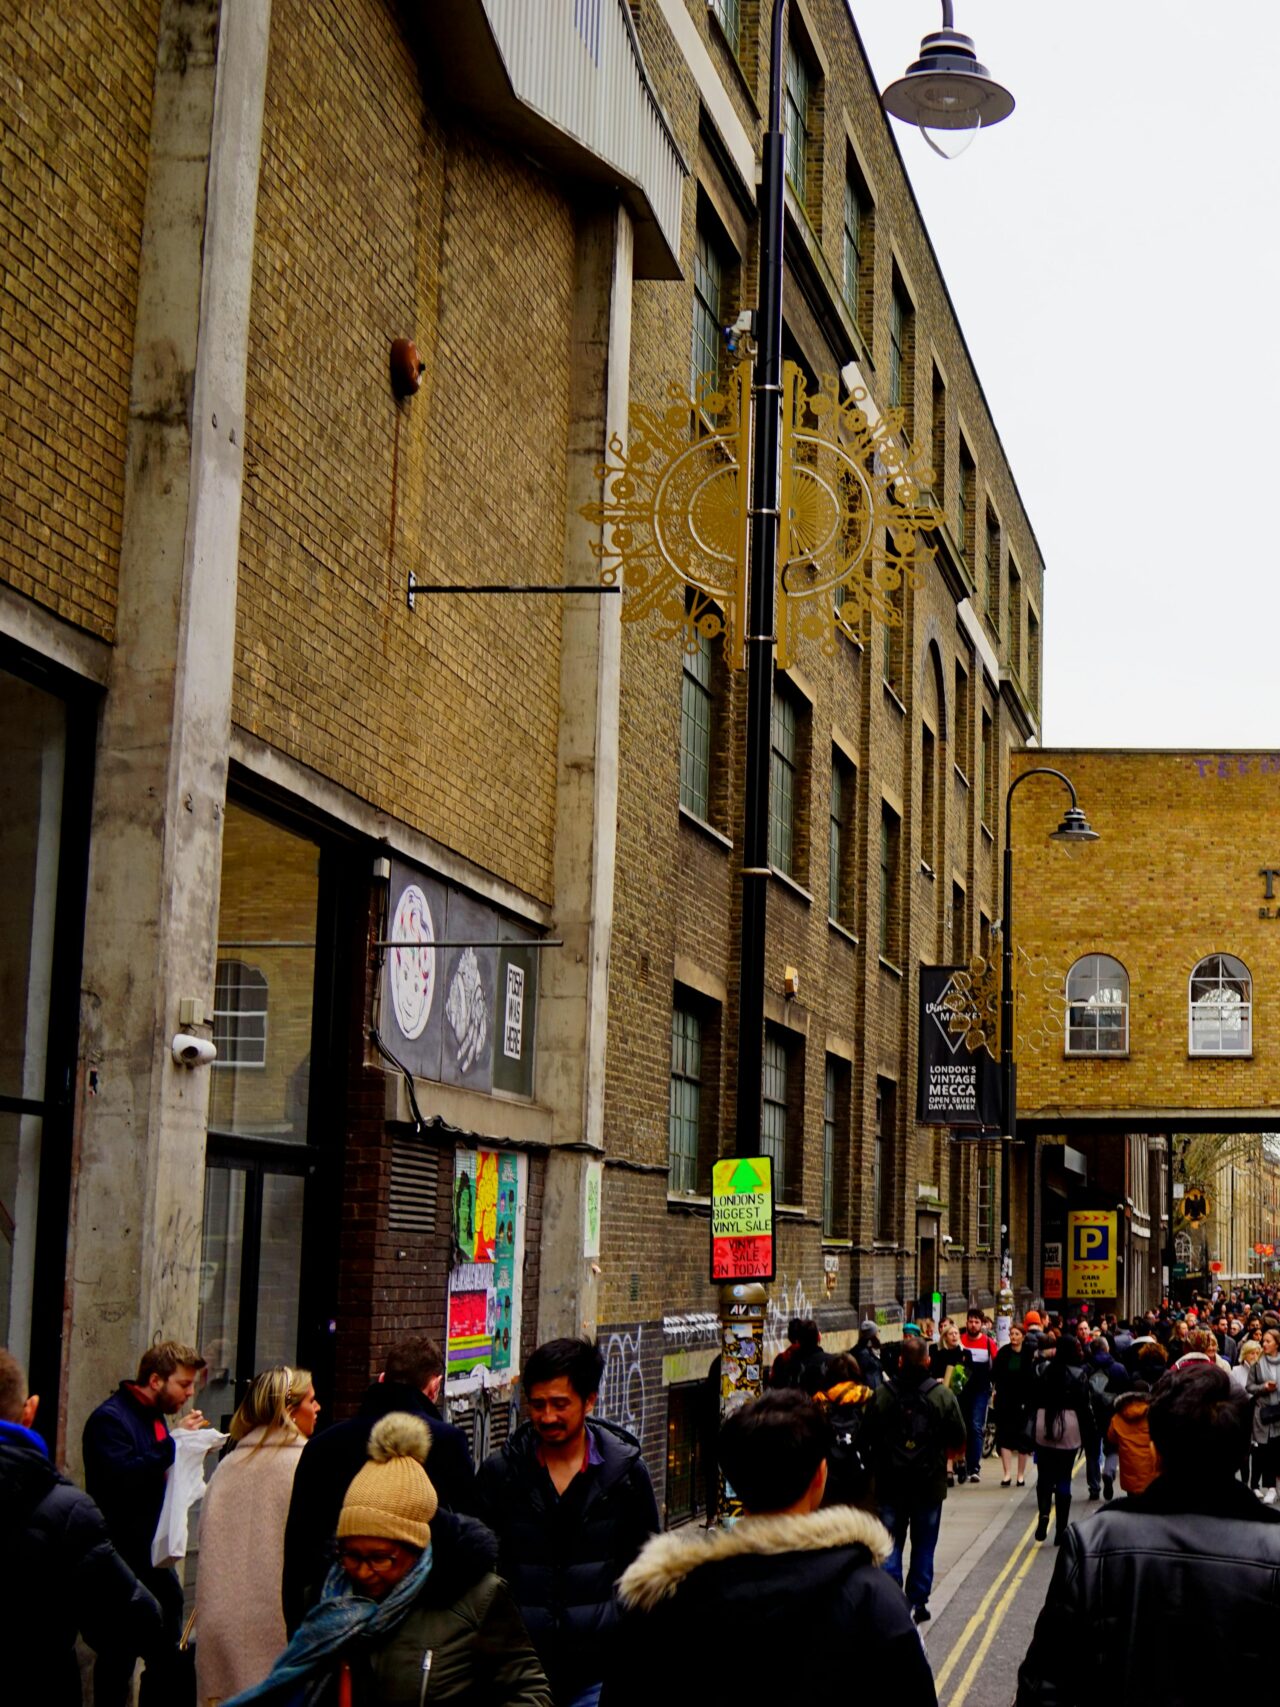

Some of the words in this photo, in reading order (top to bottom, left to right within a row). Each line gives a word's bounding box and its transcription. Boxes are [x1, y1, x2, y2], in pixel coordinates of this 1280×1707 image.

[508, 1000, 521, 1025] WAS
[506, 1024, 521, 1055] HERE
[930, 1065, 977, 1074] LONDON'S
[930, 1075, 977, 1084] VINTAGE
[929, 1085, 976, 1096] MECCA
[951, 1096, 976, 1104] SEVEN
[928, 1103, 947, 1111] DAYS
[955, 1103, 976, 1111] WEEK
[713, 1193, 765, 1208] LONDONS
[713, 1206, 761, 1221] BIGGEST
[713, 1221, 743, 1233] VINYL
[745, 1219, 772, 1232] SALE
[728, 1238, 760, 1250] VINYL
[1080, 1227, 1103, 1259] P
[732, 1251, 760, 1262] SALE
[714, 1264, 729, 1276] ON
[733, 1263, 769, 1276] TODAY
